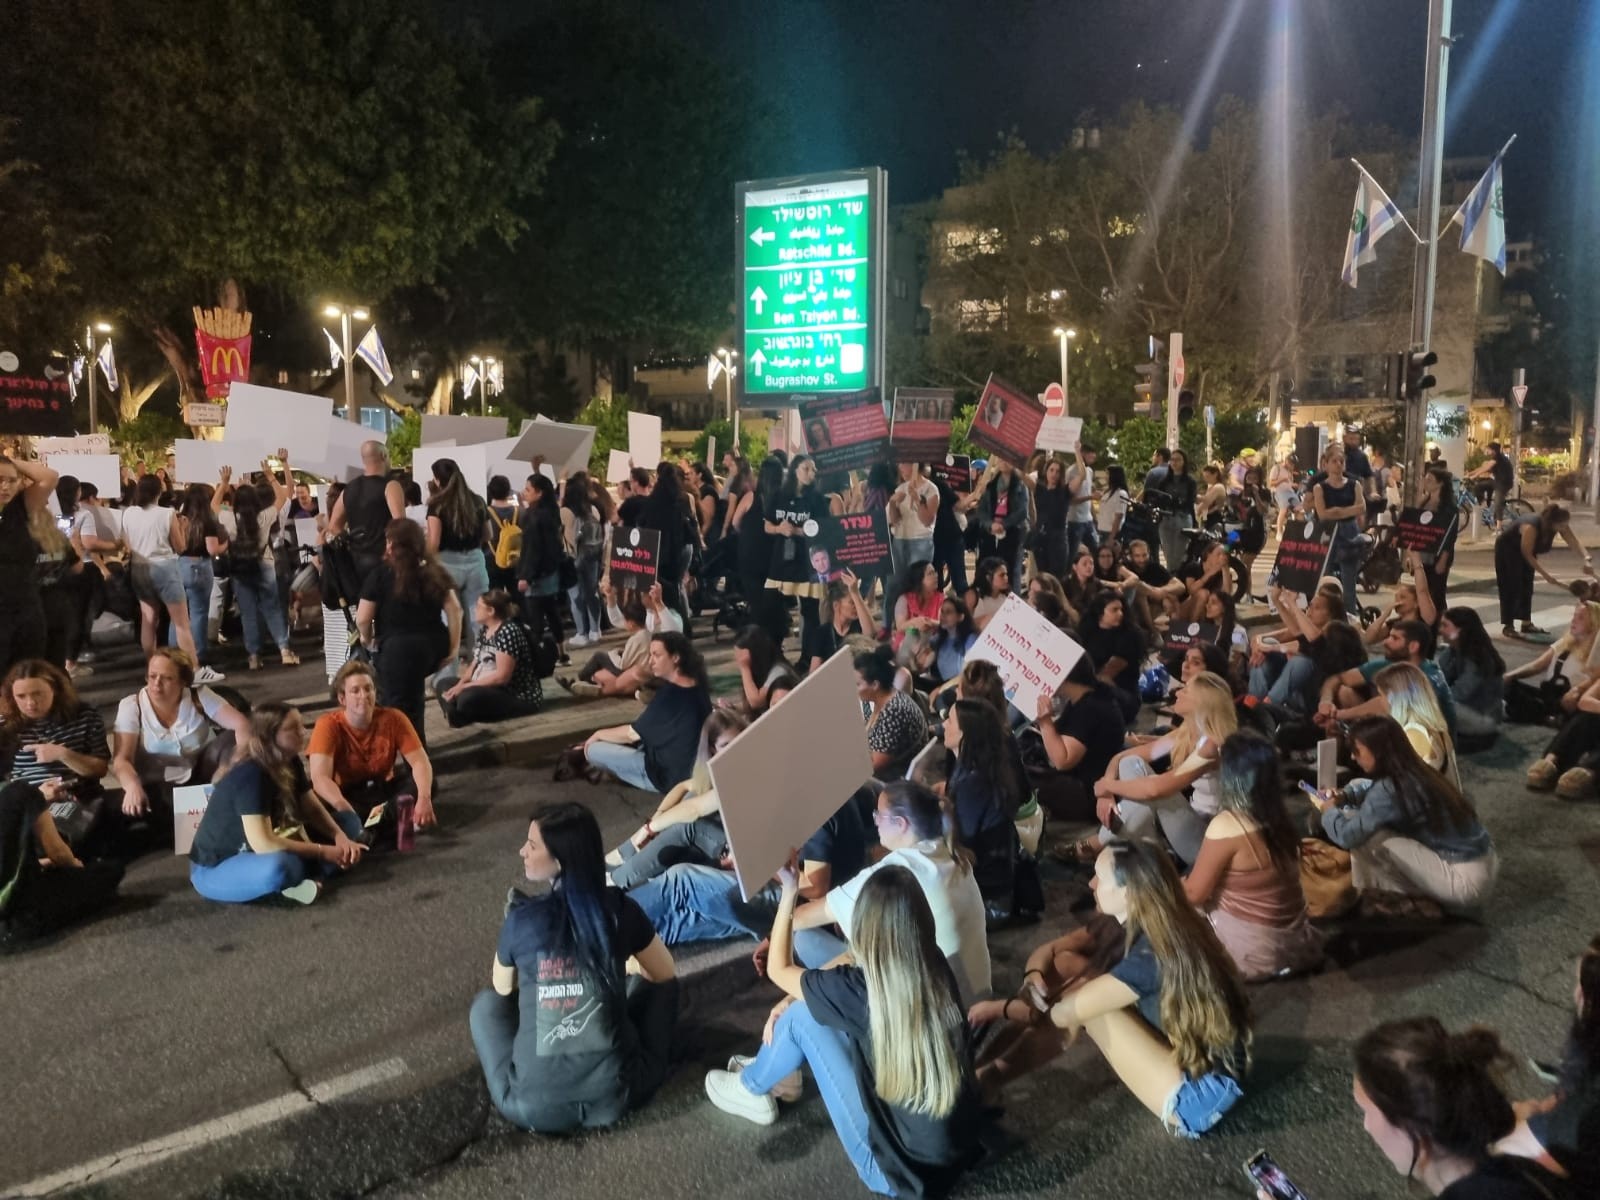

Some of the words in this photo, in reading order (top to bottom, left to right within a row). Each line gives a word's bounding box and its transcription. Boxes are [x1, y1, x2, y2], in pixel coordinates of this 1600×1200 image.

[765, 374, 819, 389] Bugrashov
[823, 372, 838, 385] St.
[1002, 623, 1032, 652] החינוך
[1035, 648, 1061, 676] משרד
[1015, 659, 1041, 686] משרד
[1041, 682, 1054, 697] או
[539, 985, 566, 1002] המאבק
[566, 983, 583, 996] מטה
